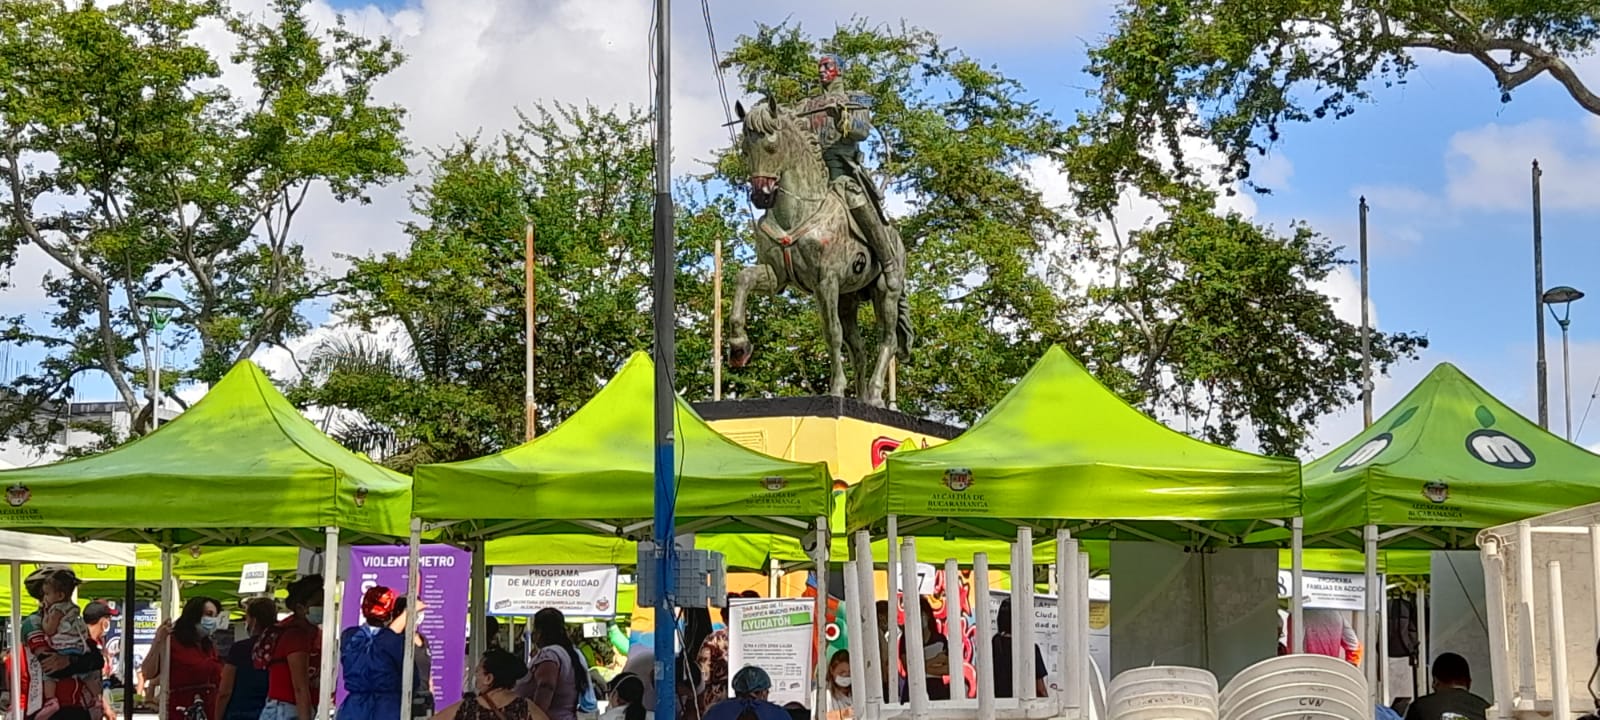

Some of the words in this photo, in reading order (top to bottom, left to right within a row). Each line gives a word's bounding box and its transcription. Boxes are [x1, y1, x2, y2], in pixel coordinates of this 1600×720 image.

[362, 555, 455, 568] VIOLENTMETRO
[529, 568, 580, 577] PROGRAMA
[507, 578, 519, 587] DE
[521, 578, 552, 587] MUJER
[553, 579, 559, 587] Y
[560, 578, 600, 588] EQUIDAD
[1318, 576, 1353, 584] PROGRAMA
[1306, 583, 1333, 591] FAMILIAS
[525, 589, 537, 597] DE
[538, 587, 581, 598] GÉNEROS
